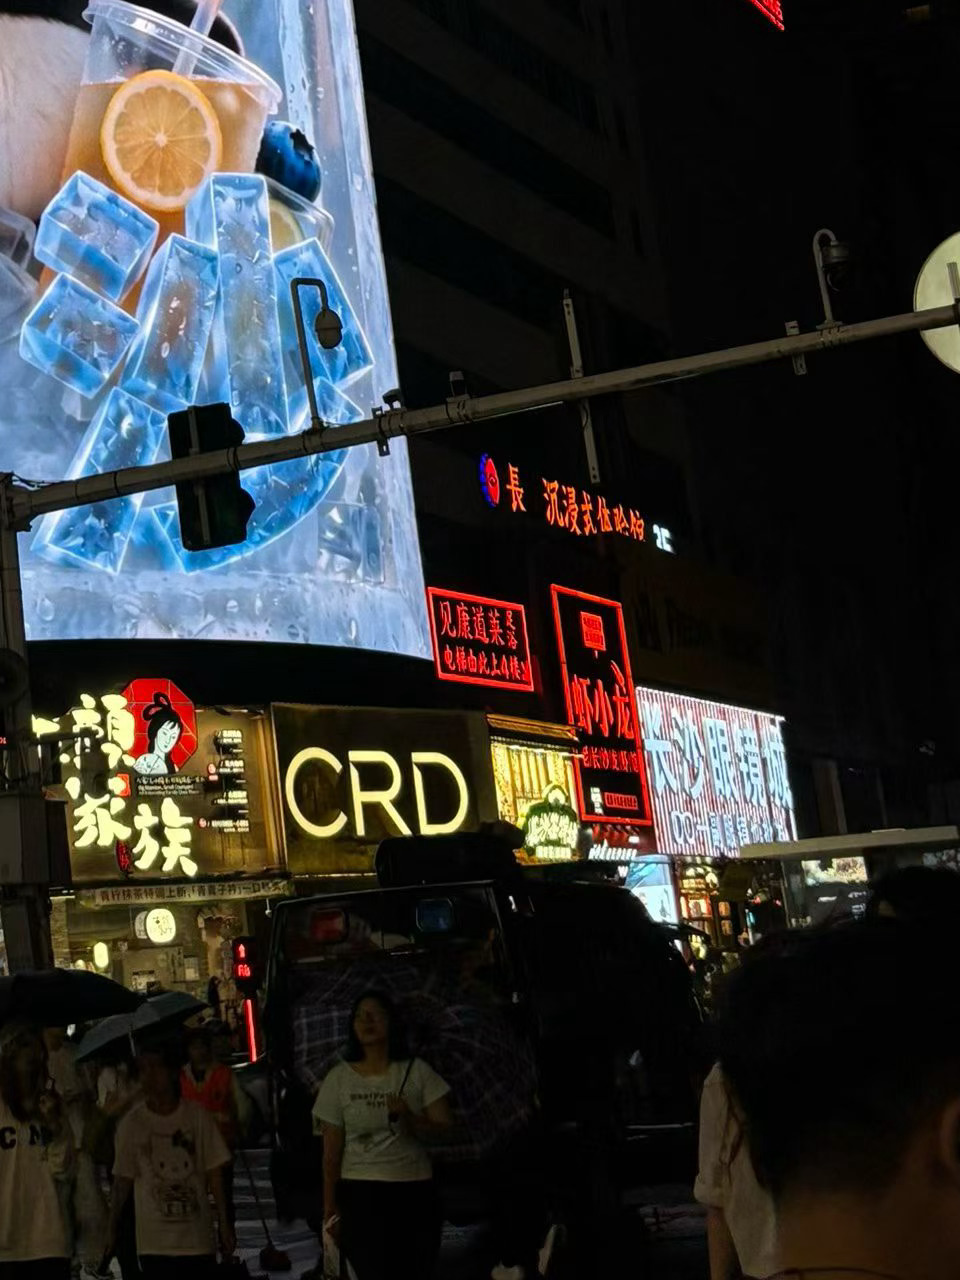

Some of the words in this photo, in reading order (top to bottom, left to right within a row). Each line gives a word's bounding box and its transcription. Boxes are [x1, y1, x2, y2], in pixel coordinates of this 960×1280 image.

[285, 746, 469, 838] CRD
[642, 697, 797, 811] 长沙眼镜城
